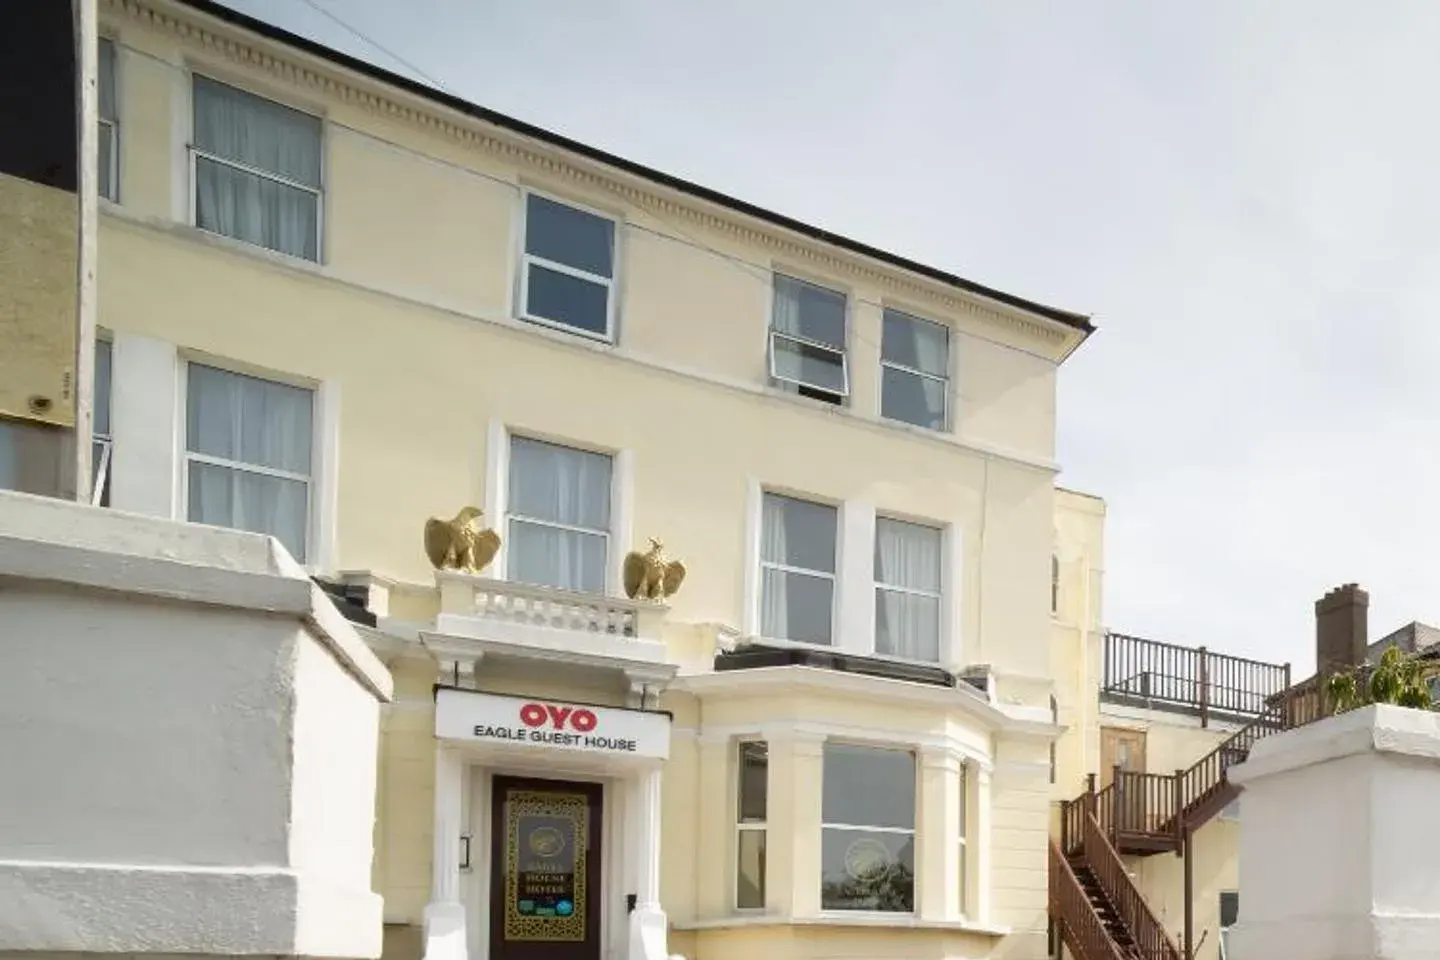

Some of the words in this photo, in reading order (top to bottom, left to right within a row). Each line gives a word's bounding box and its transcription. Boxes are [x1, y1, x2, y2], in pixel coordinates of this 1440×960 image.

[520, 704, 597, 732] OYO
[474, 725, 526, 740] EAGLE
[530, 730, 582, 746] GUEST
[584, 736, 637, 751] HOUSE
